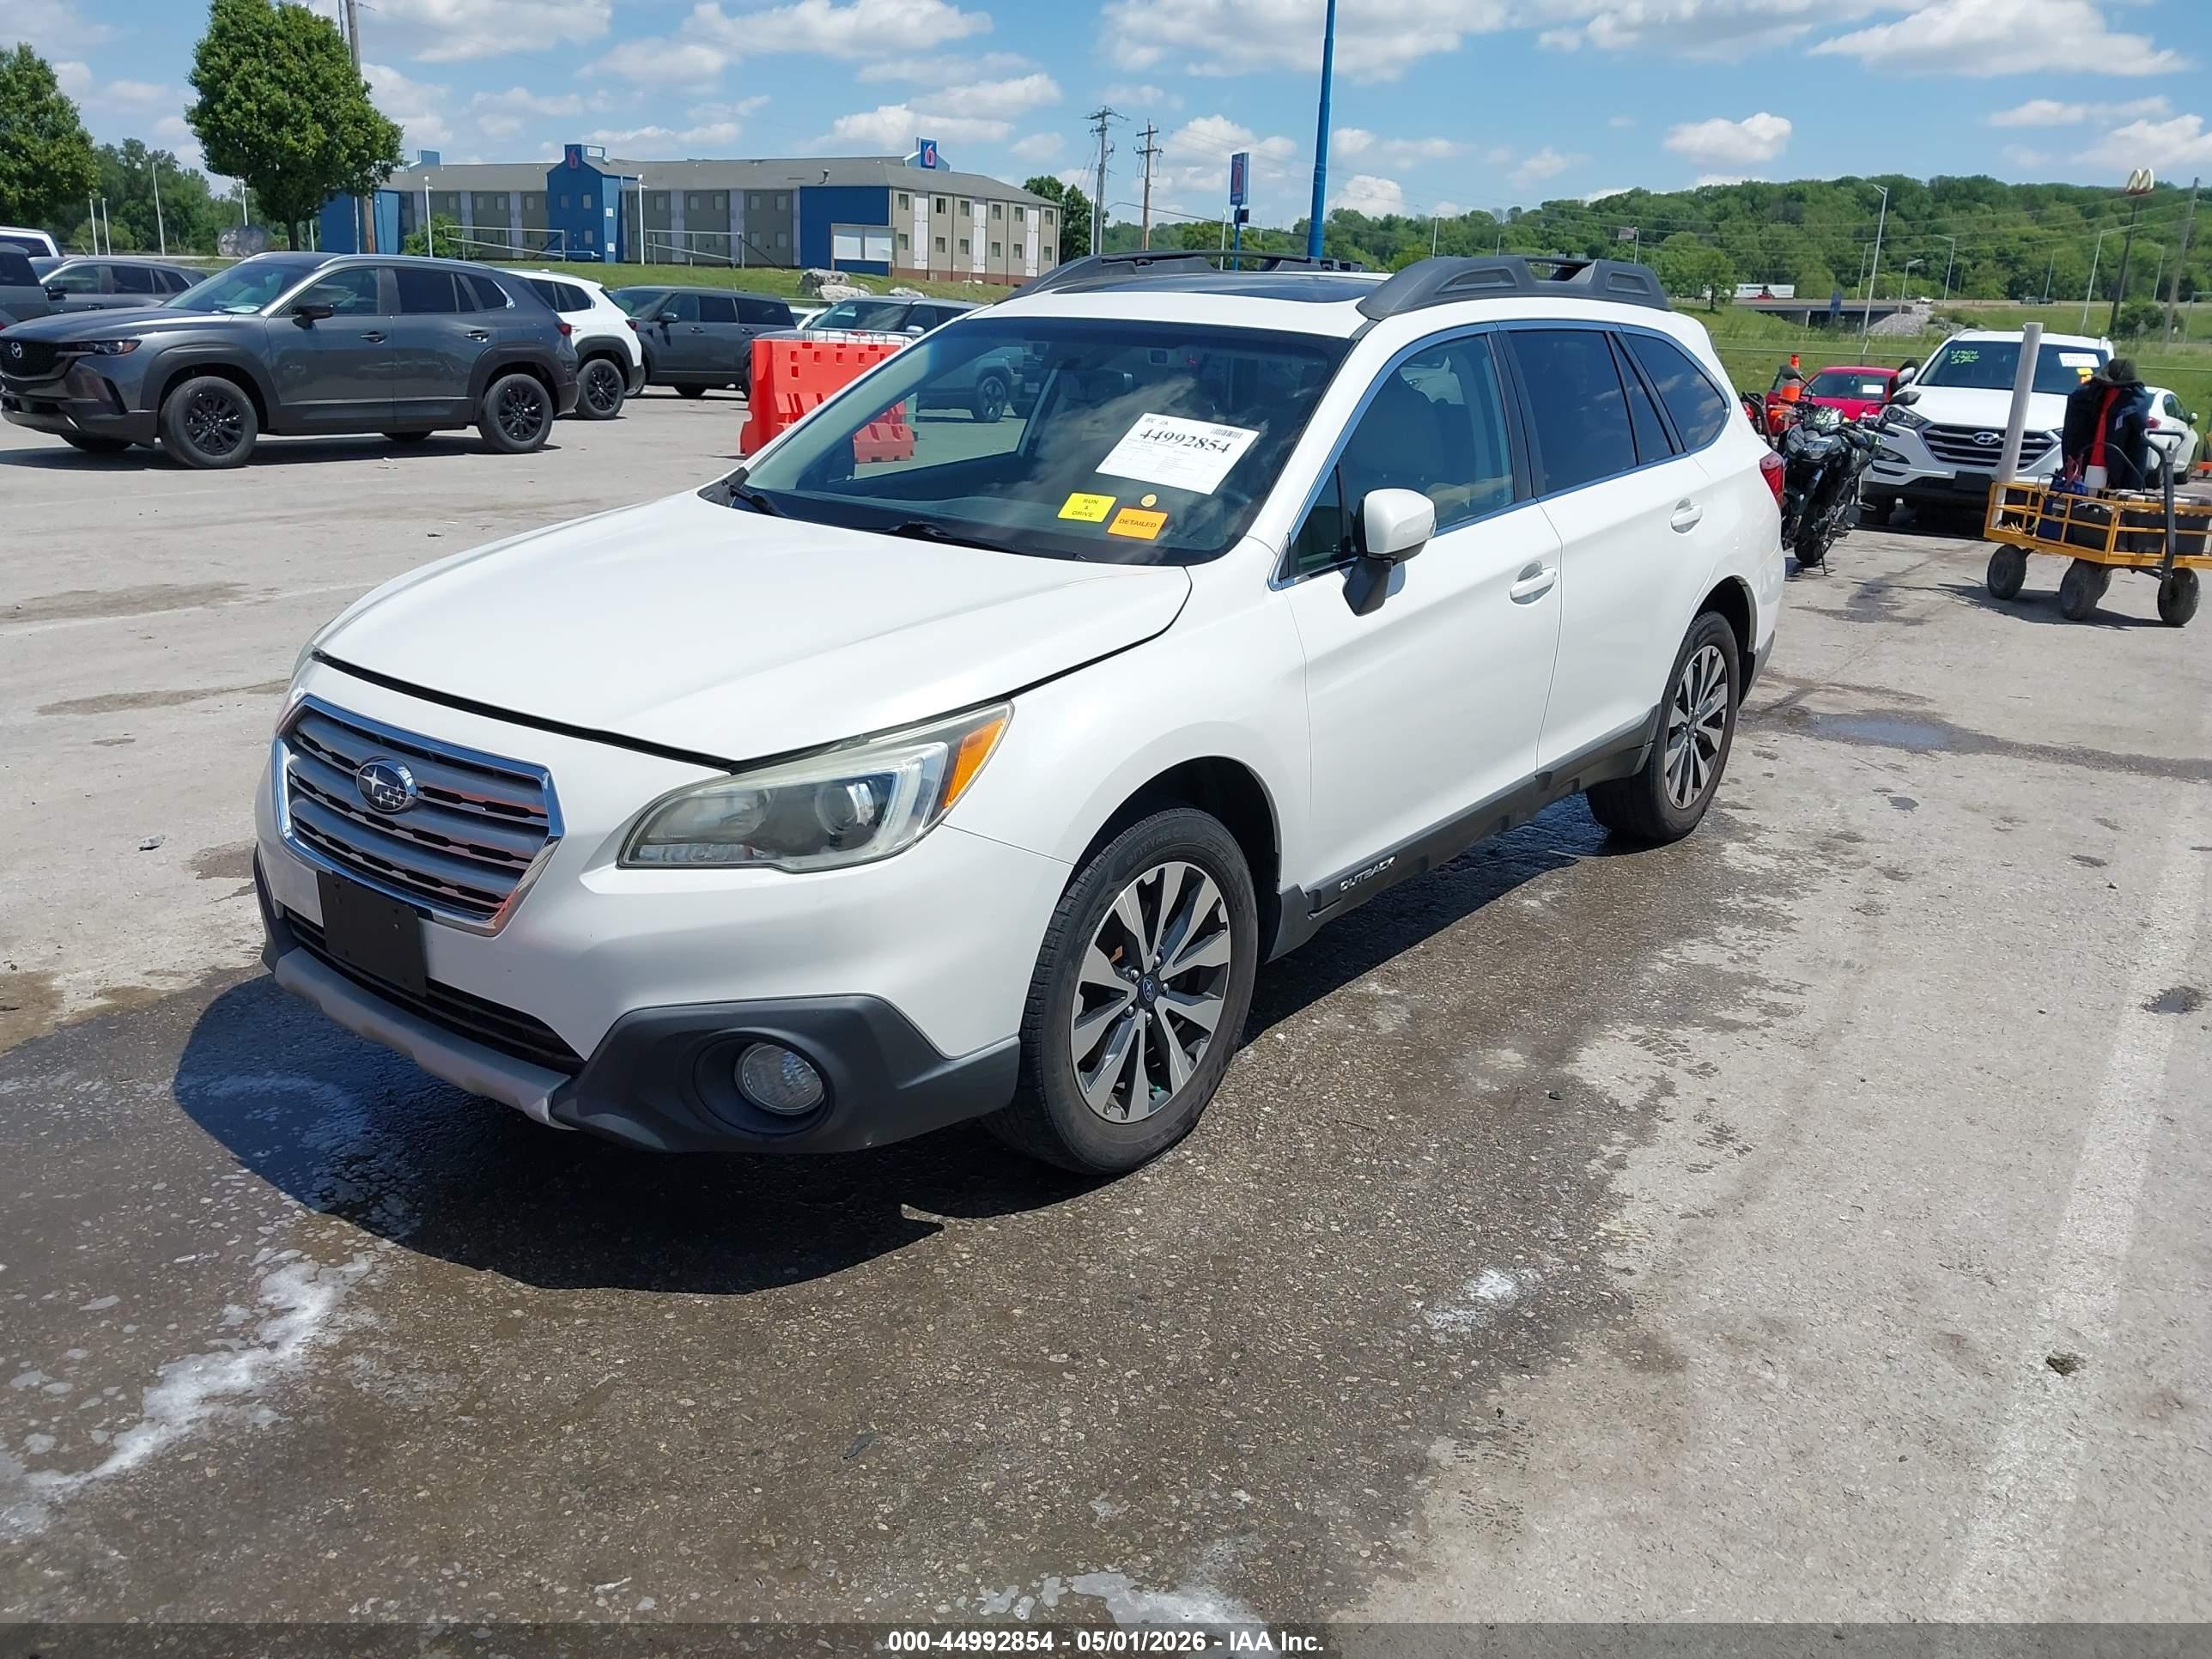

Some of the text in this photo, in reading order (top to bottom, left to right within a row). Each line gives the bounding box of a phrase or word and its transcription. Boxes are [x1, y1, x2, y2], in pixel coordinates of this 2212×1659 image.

[925, 144, 935, 167] 6
[1139, 428, 1231, 453] 44992854
[1118, 518, 1158, 528] DETAILED
[1340, 856, 1396, 891] OUTBACK
